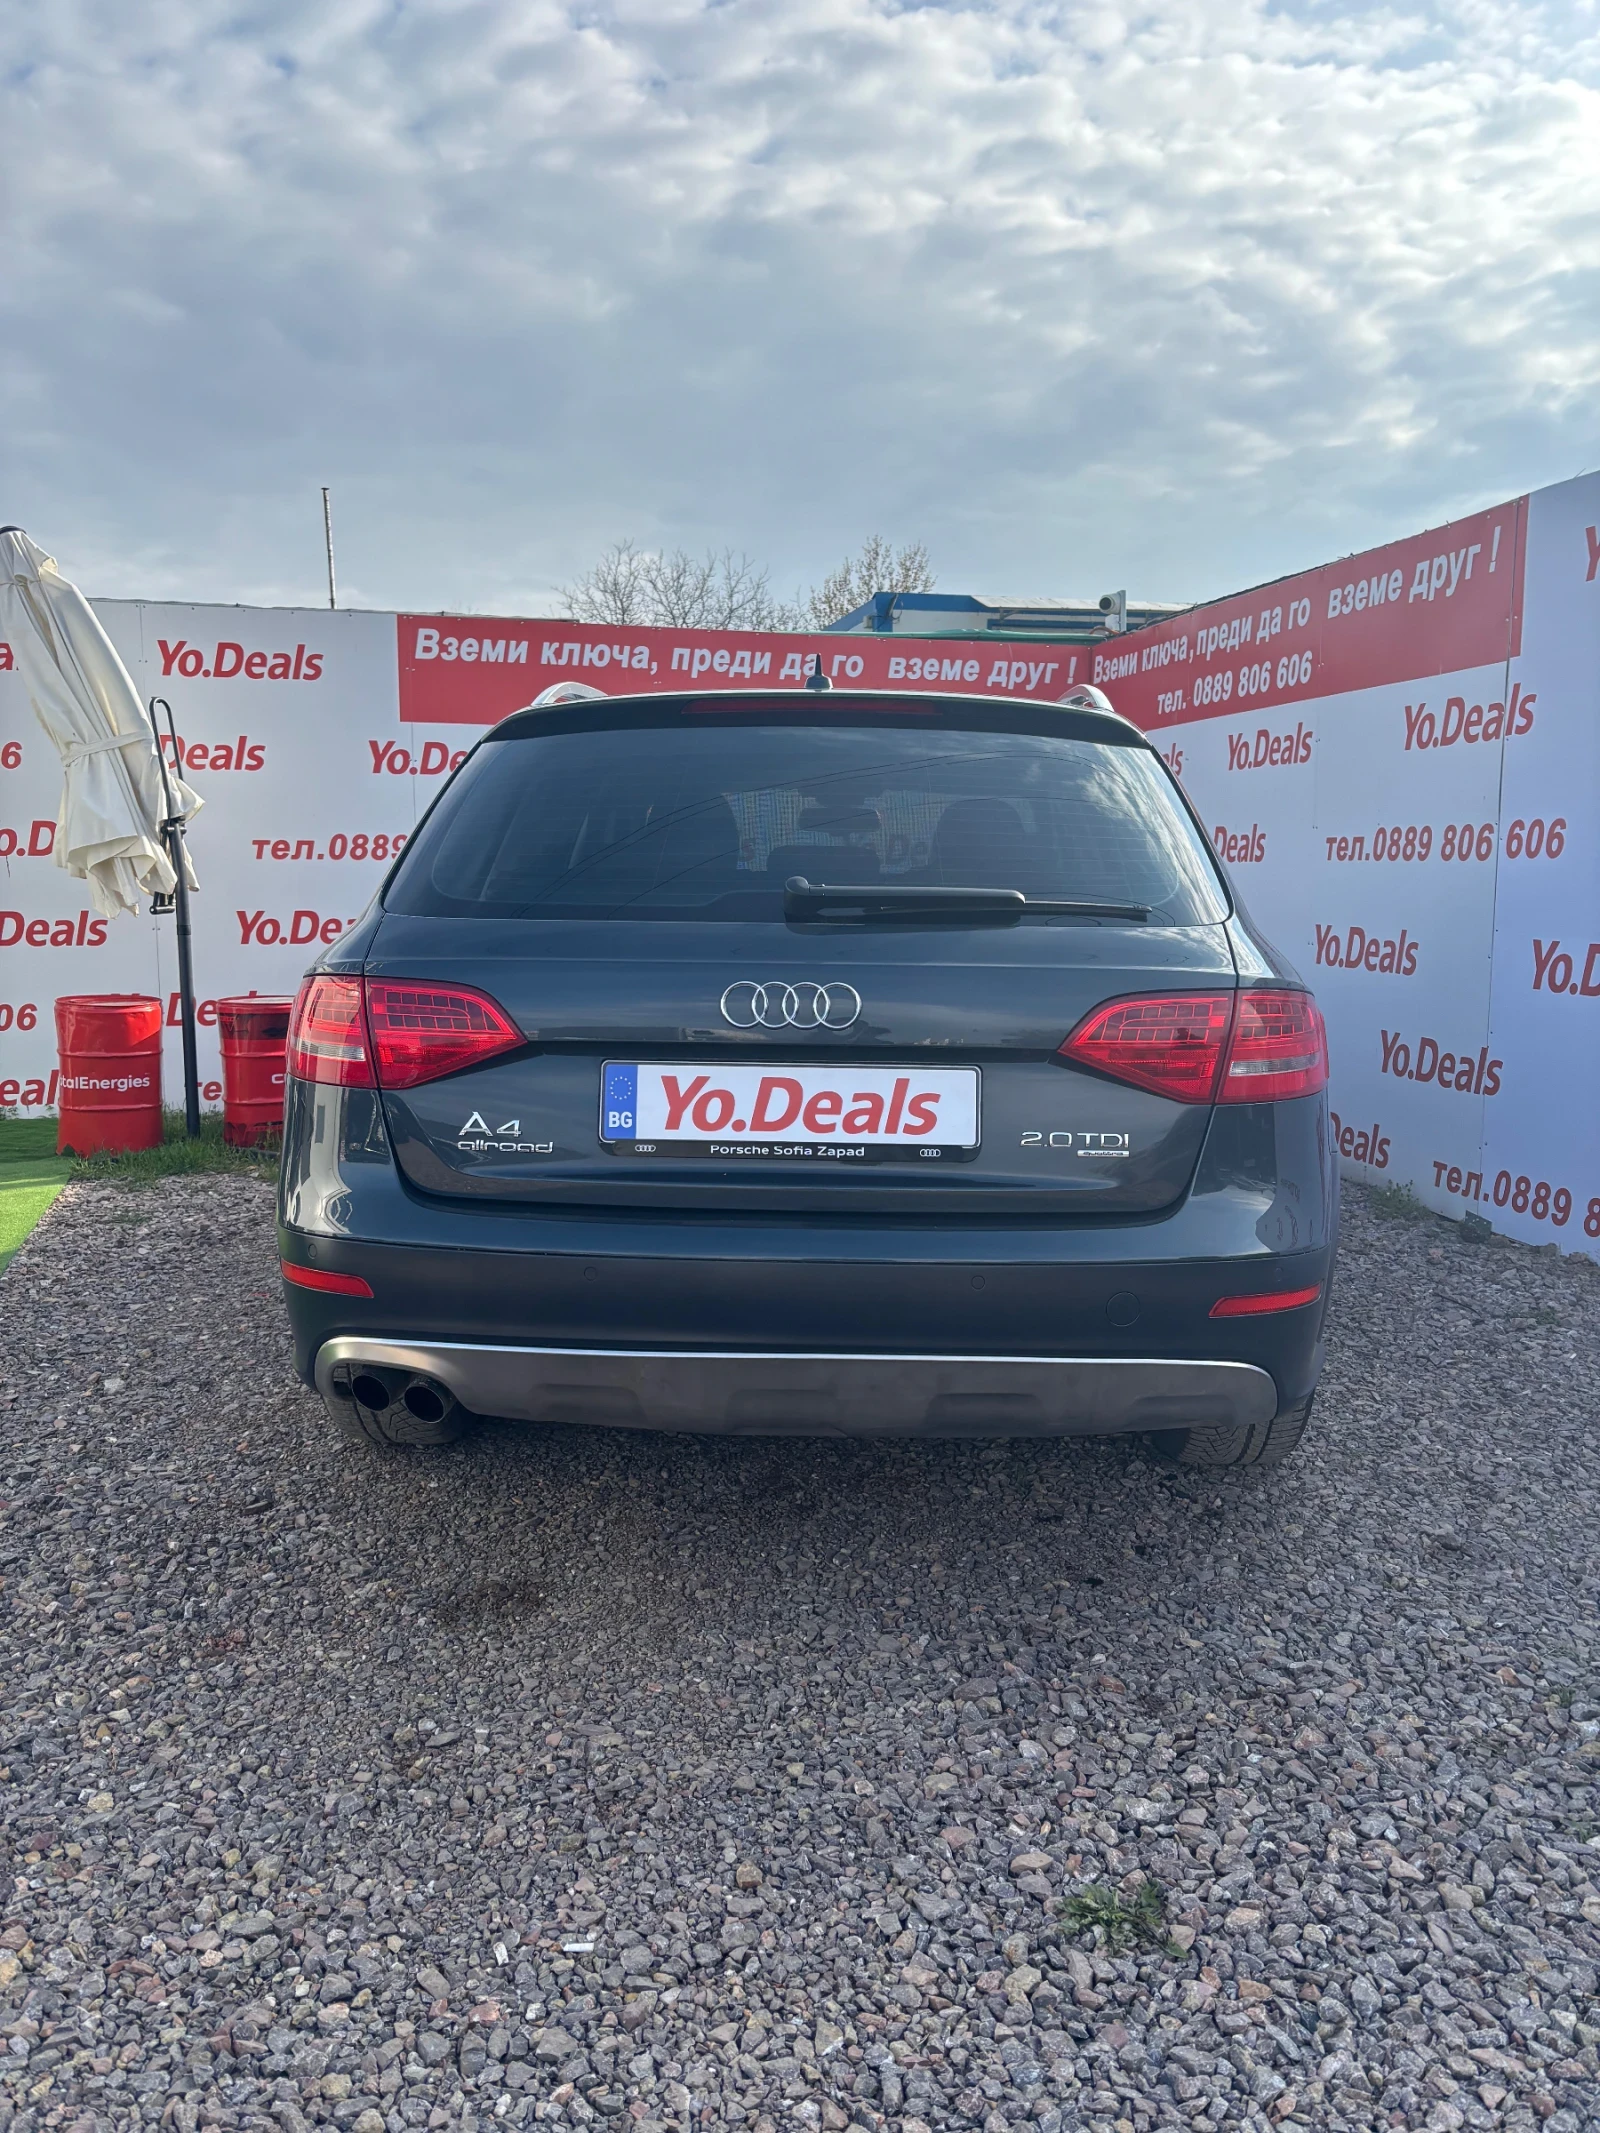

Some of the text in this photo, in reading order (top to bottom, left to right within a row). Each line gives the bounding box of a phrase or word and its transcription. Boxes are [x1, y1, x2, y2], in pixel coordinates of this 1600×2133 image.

[1093, 652, 1138, 684] Вземи
[1142, 635, 1194, 671] ключа,
[1197, 616, 1253, 661] преди
[1256, 606, 1282, 645] да
[1288, 597, 1311, 629] го
[1327, 568, 1402, 619] вземе
[1408, 543, 1481, 603] друг
[157, 640, 324, 680] Yo.Deals
[414, 628, 528, 664] Вземи
[540, 641, 658, 675] ключа,
[671, 647, 771, 678] преди
[831, 655, 864, 678] го
[888, 657, 980, 682] вземе
[987, 660, 1059, 690] друг
[1158, 651, 1313, 715] тел. 0889 806 606
[1403, 683, 1537, 751] Yo.Deals
[1228, 722, 1313, 772] Yo.Deals
[1440, 823, 1493, 863] 806
[1505, 818, 1566, 860] 606
[236, 910, 357, 946] Yo.De
[1314, 924, 1419, 976] Yo.Deals
[1381, 1029, 1503, 1096] Yo.Deals
[458, 1111, 522, 1137] A4
[608, 1110, 633, 1129] BG
[660, 1075, 942, 1136] Yo.Deals
[457, 1139, 554, 1153] allroad
[710, 1145, 865, 1158] Porsche Sofia Zapad
[1020, 1131, 1129, 1148] 2.0 TDI
